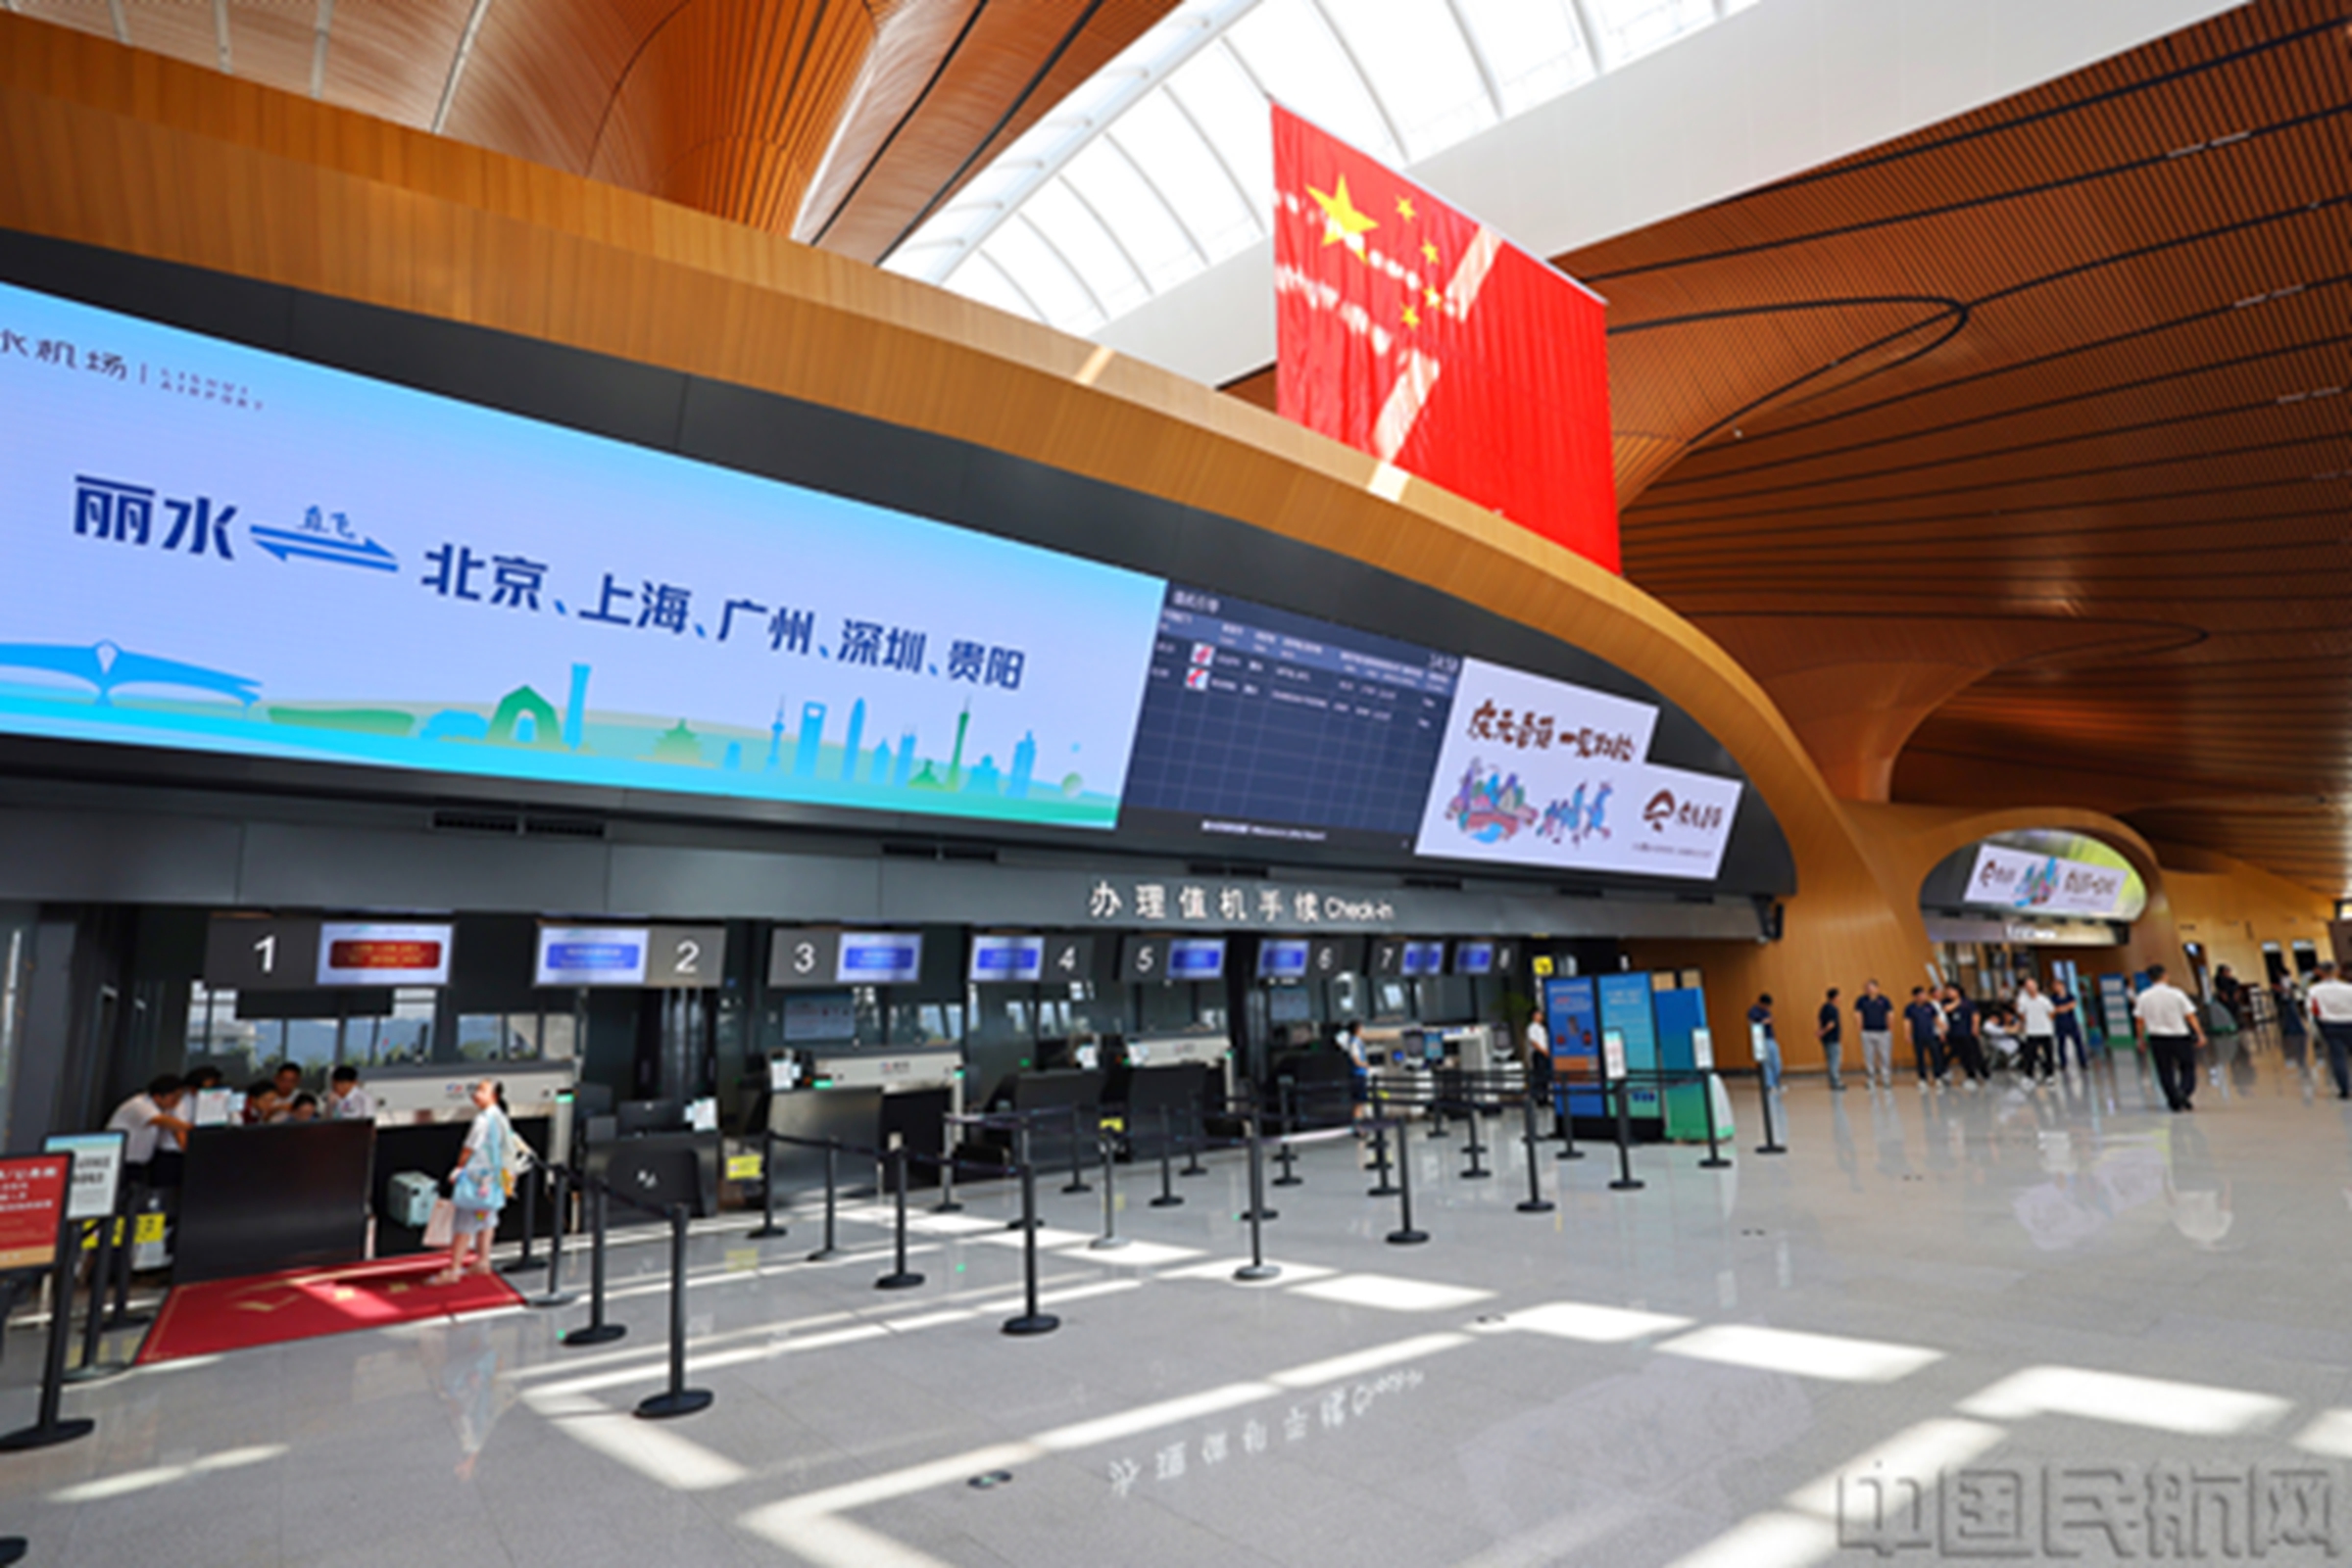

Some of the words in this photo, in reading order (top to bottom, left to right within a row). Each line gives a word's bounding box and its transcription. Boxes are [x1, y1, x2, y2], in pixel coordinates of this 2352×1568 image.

[74, 474, 238, 560] 丽水
[298, 505, 356, 539] 直飞
[1089, 880, 1319, 922] 办理值机手续
[1324, 896, 1396, 922] Check-in
[254, 936, 276, 972] 1
[675, 941, 701, 973] 2
[794, 943, 816, 973] 3
[1058, 946, 1077, 970] 4
[1136, 945, 1154, 970] 5
[1380, 948, 1394, 968] 7
